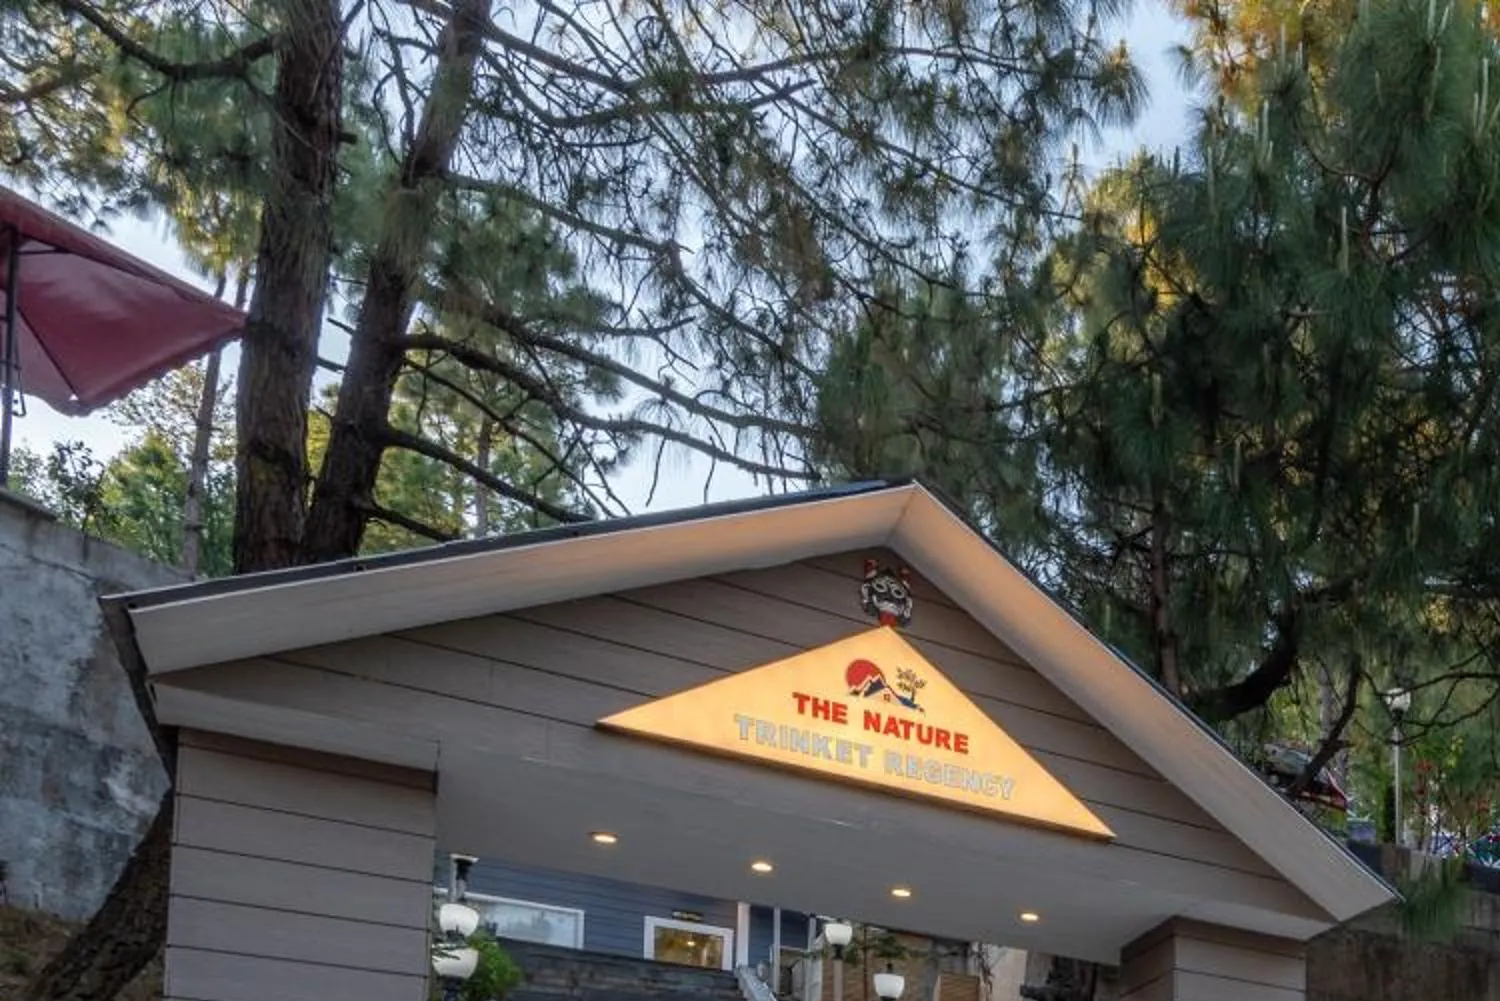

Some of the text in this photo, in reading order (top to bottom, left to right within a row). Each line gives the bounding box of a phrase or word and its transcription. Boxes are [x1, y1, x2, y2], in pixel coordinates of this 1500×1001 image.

[734, 713, 1016, 800] TRINKET REGENCY
[792, 691, 970, 754] THE NATURE
